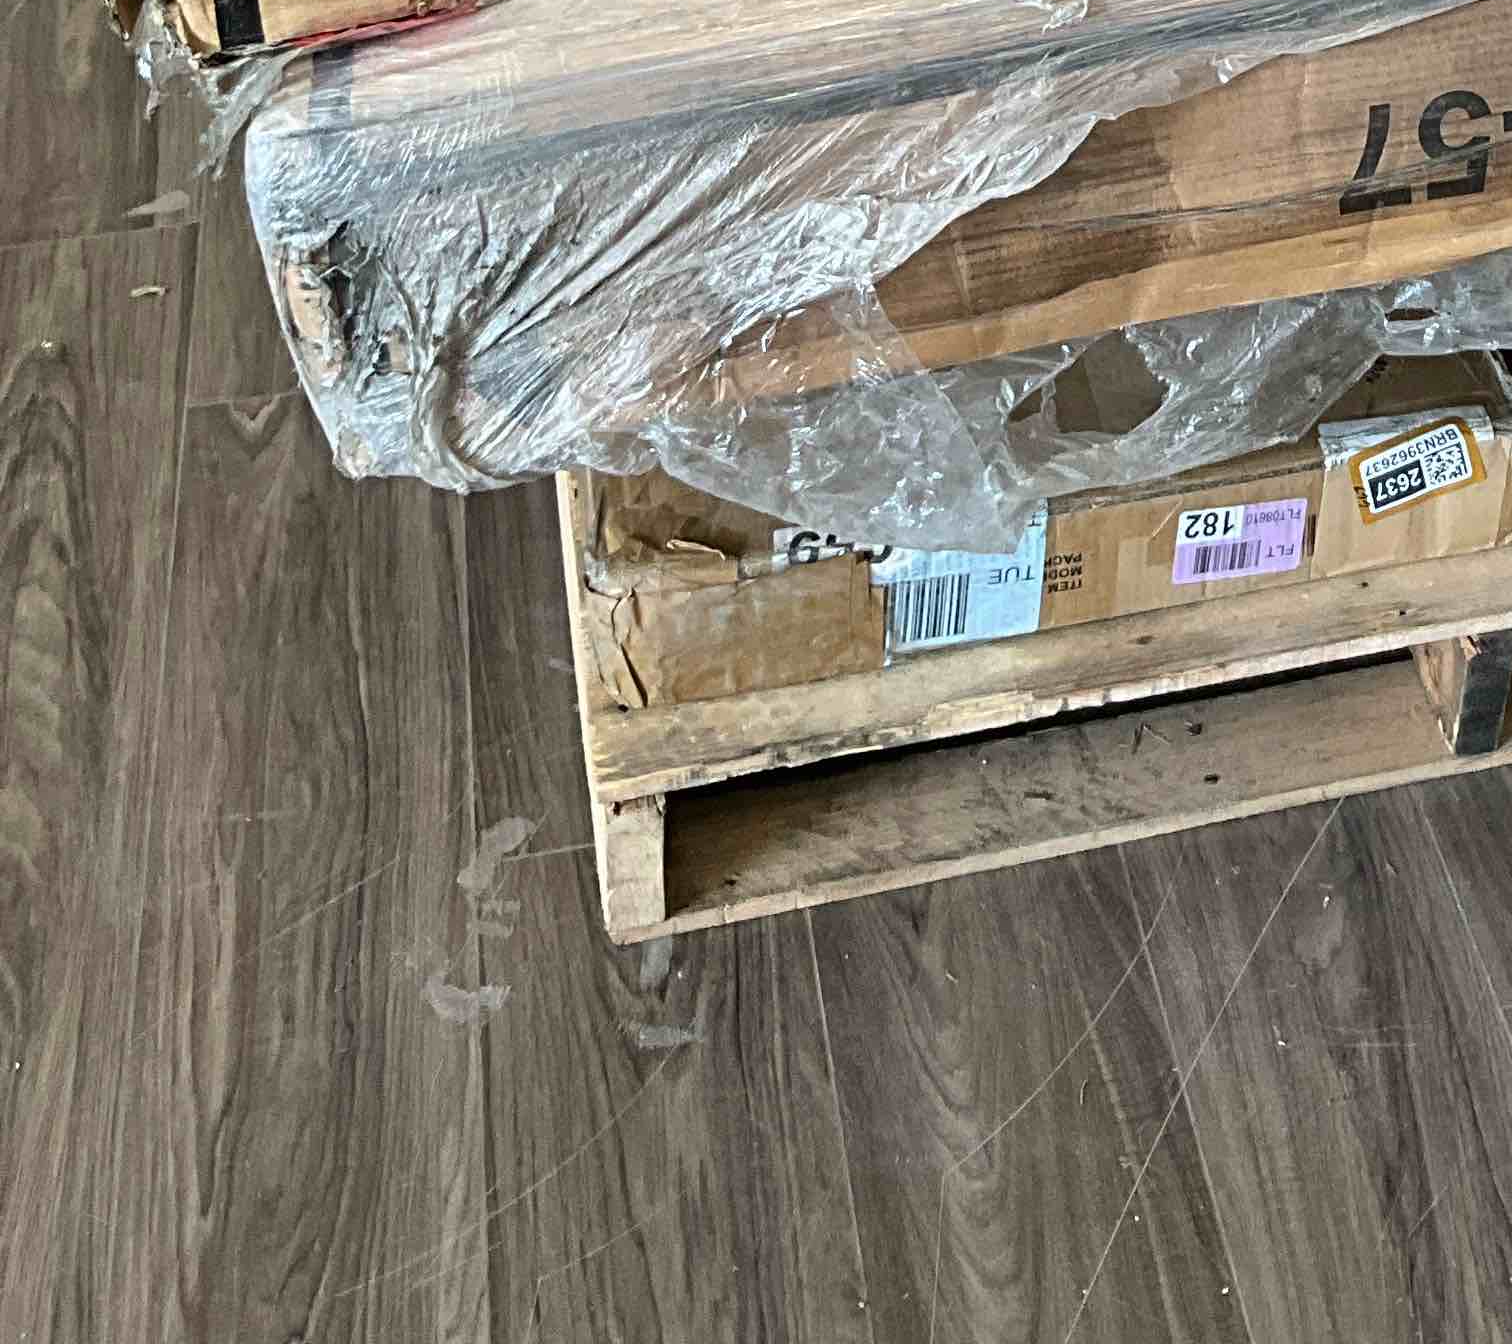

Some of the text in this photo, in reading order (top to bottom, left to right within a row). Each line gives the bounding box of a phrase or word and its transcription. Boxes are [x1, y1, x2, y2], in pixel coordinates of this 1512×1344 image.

[1365, 428, 1458, 477] BRN3962637
[1374, 467, 1422, 502] 2637
[1184, 510, 1235, 540] 182
[1264, 543, 1295, 559] FLT
[987, 564, 1036, 585] TUE
[1047, 578, 1083, 594] ITEM
